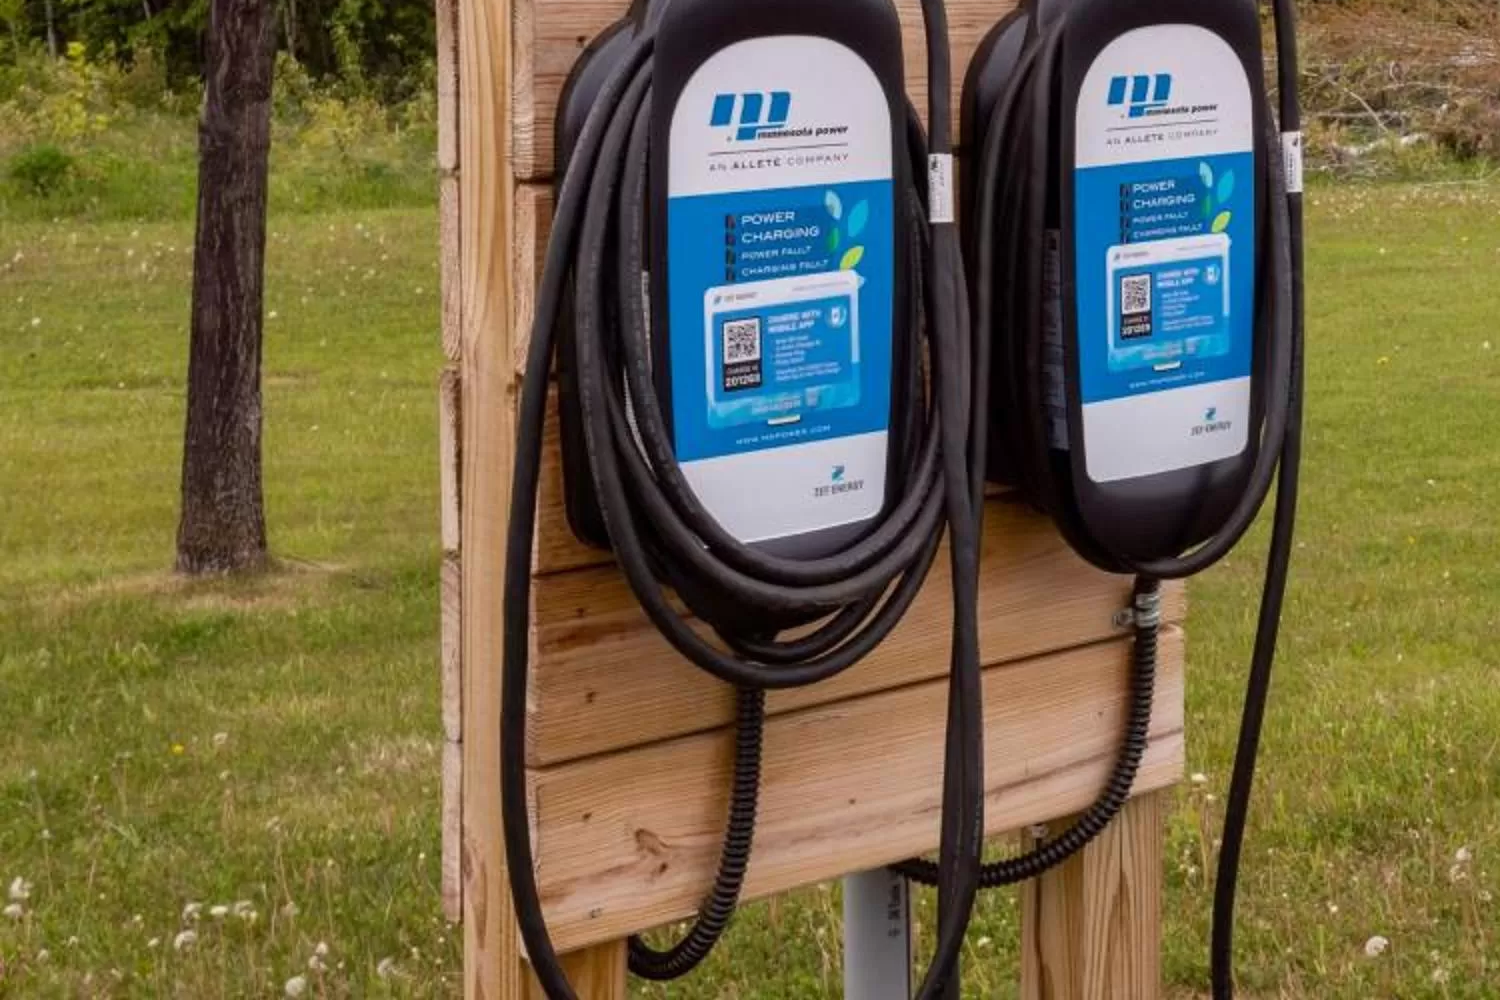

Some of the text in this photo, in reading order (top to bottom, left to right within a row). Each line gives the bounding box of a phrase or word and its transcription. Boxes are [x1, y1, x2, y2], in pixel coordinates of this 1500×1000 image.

[815, 126, 848, 136] power
[709, 153, 849, 172] AN ALLETE COMPANY
[1133, 180, 1175, 193] POWER
[1133, 194, 1196, 209] CHARGING
[741, 211, 795, 225] POWER
[741, 226, 819, 243] CHARGING
[741, 245, 812, 260] POWER FAULT
